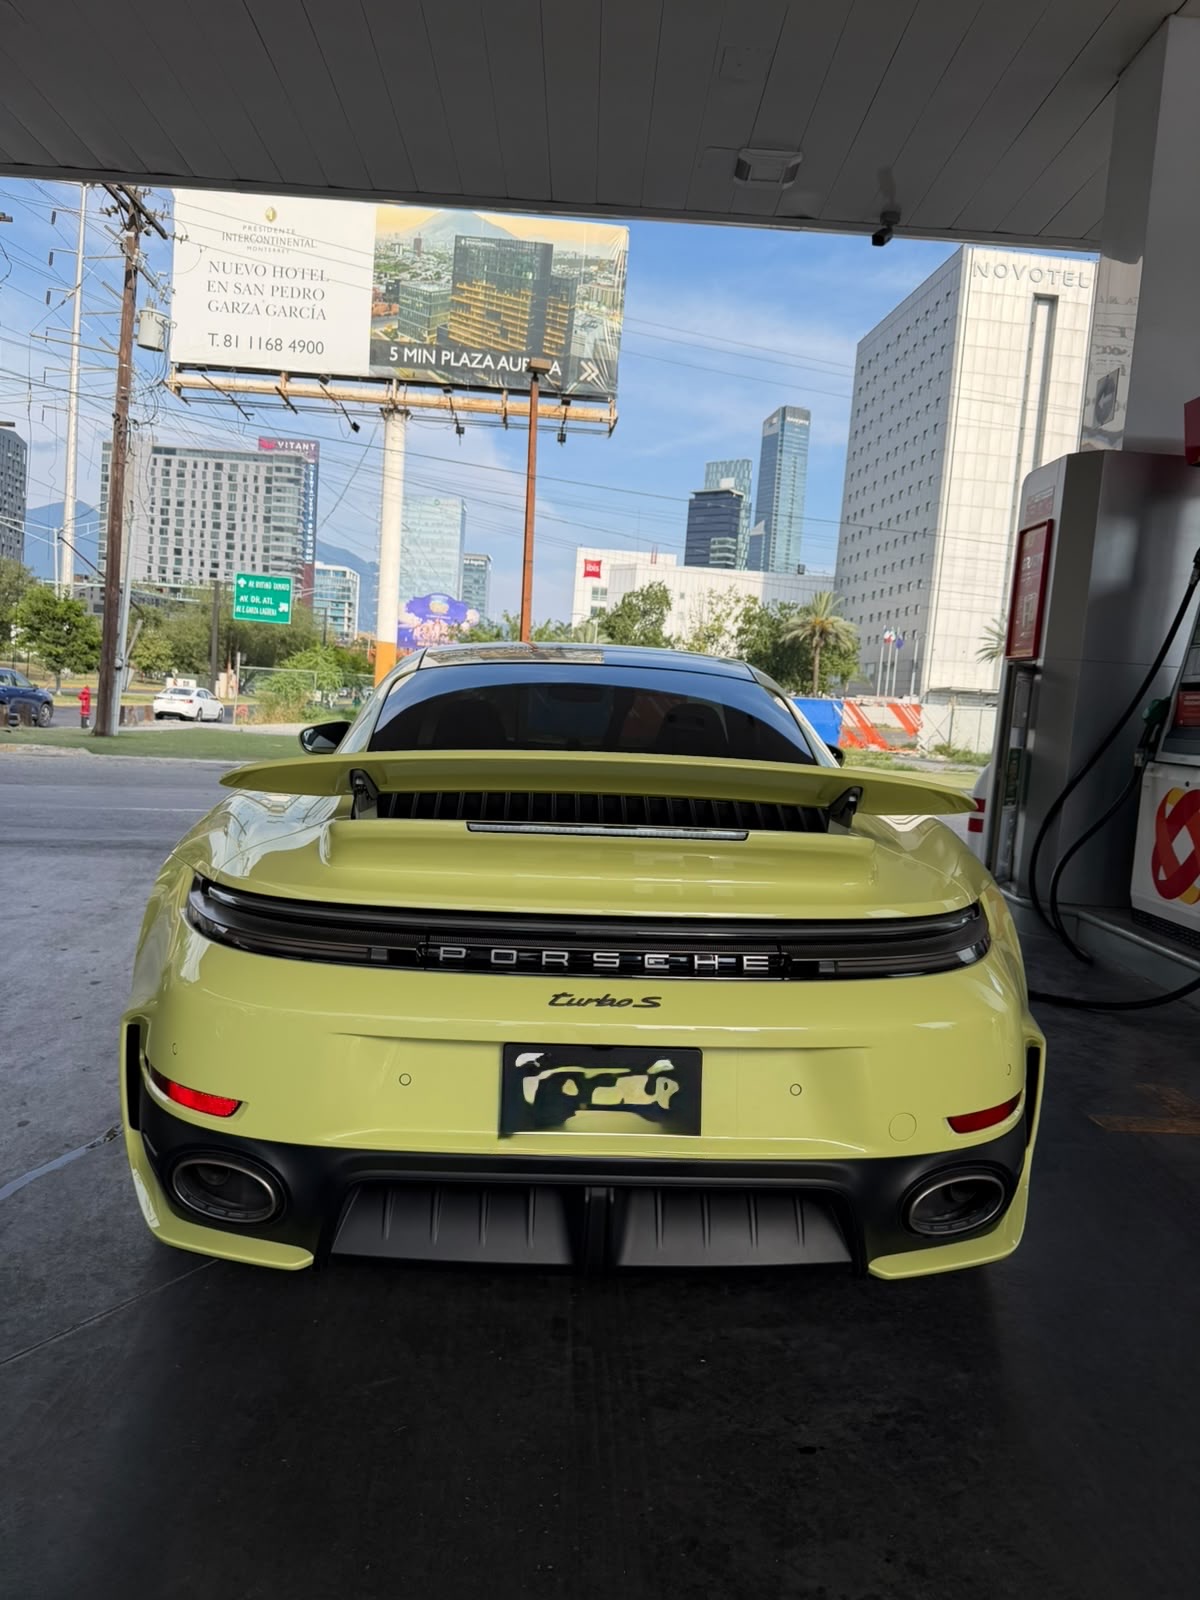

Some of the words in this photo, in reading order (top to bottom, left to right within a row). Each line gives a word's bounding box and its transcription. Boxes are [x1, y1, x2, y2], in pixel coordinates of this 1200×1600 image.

[222, 232, 316, 248] INTERCONTINENTAL
[242, 225, 296, 235] PRESIDENTE
[209, 260, 267, 278] NUEVO
[272, 267, 327, 282] HOTEL
[973, 261, 1090, 289] NOVOTEL
[207, 280, 230, 293] EN
[233, 283, 265, 296] SAN
[271, 286, 325, 301] PEDRO
[207, 300, 261, 316] GARZA
[265, 303, 327, 321] GARCÍA
[223, 333, 239, 349] 81
[249, 335, 284, 352] 1168
[288, 337, 325, 355] 4900
[389, 346, 399, 362] 5
[403, 347, 436, 365] MIN
[441, 350, 495, 370] PLAZA
[277, 441, 316, 451] VITANT
[586, 562, 600, 573] ibis
[439, 947, 770, 971] PORSCHE
[548, 992, 632, 1008] turbo
[632, 996, 662, 1008] S
